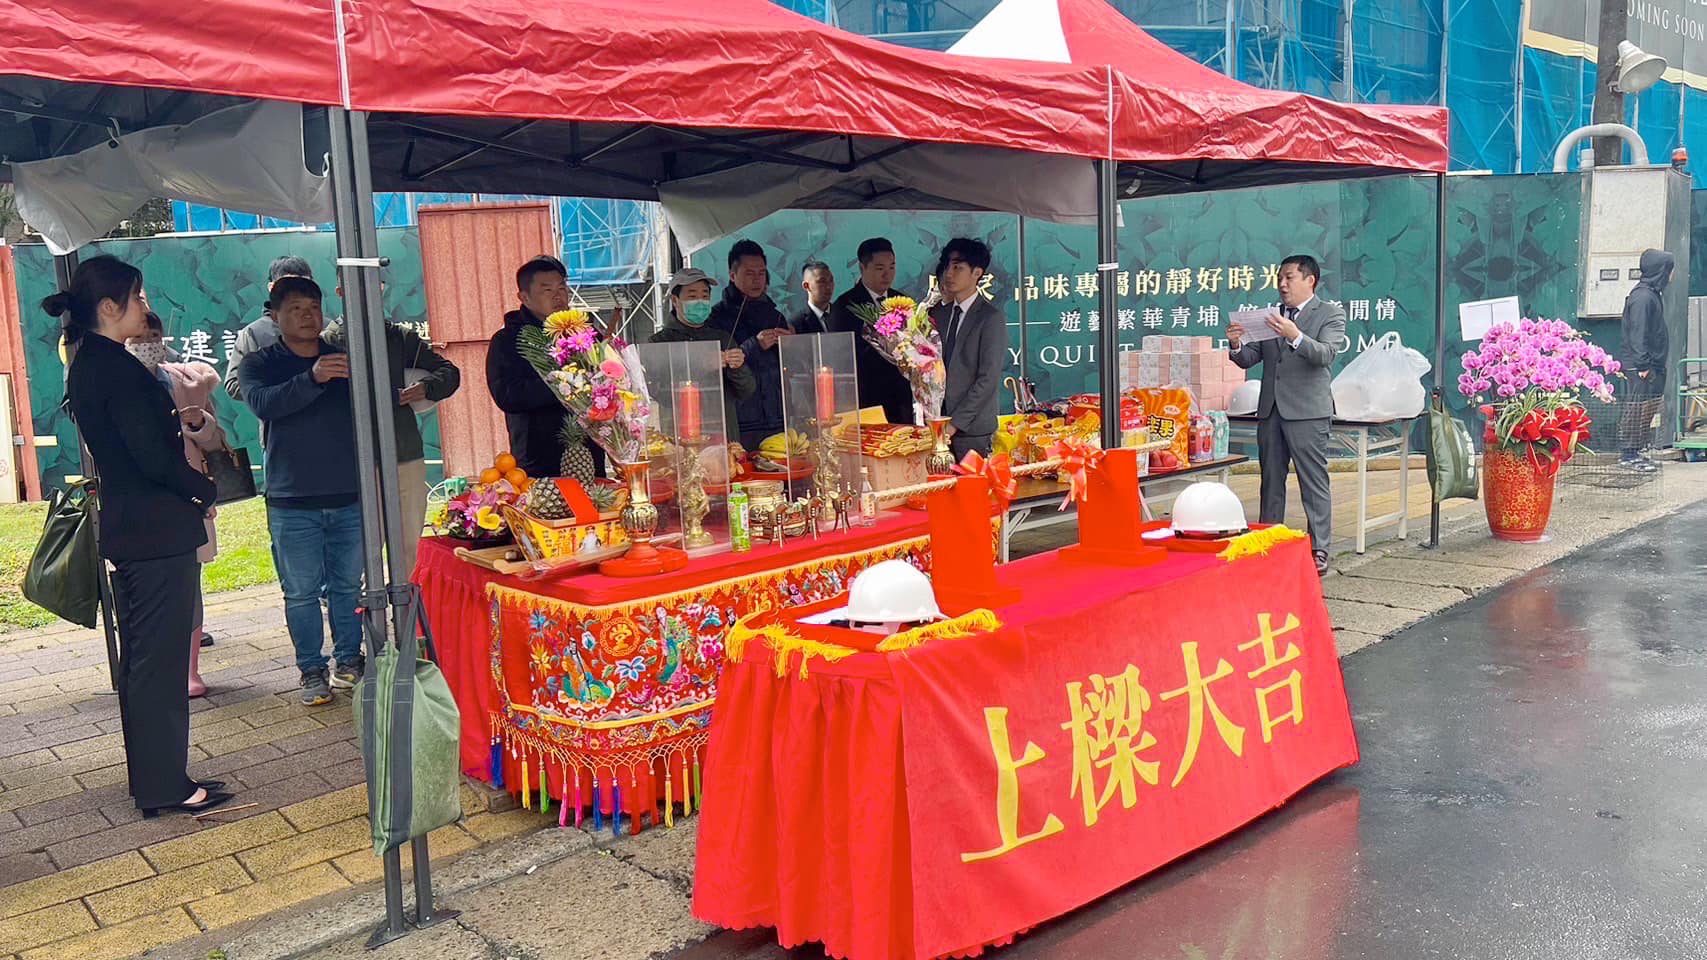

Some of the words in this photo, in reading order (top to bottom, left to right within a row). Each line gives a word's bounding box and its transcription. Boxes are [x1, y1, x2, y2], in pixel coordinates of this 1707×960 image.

[1627, 0, 1669, 30] OMING
[1674, 14, 1704, 41] SOON
[1039, 341, 1135, 368] QUIT
[960, 612, 1304, 863] 上樑大吉
